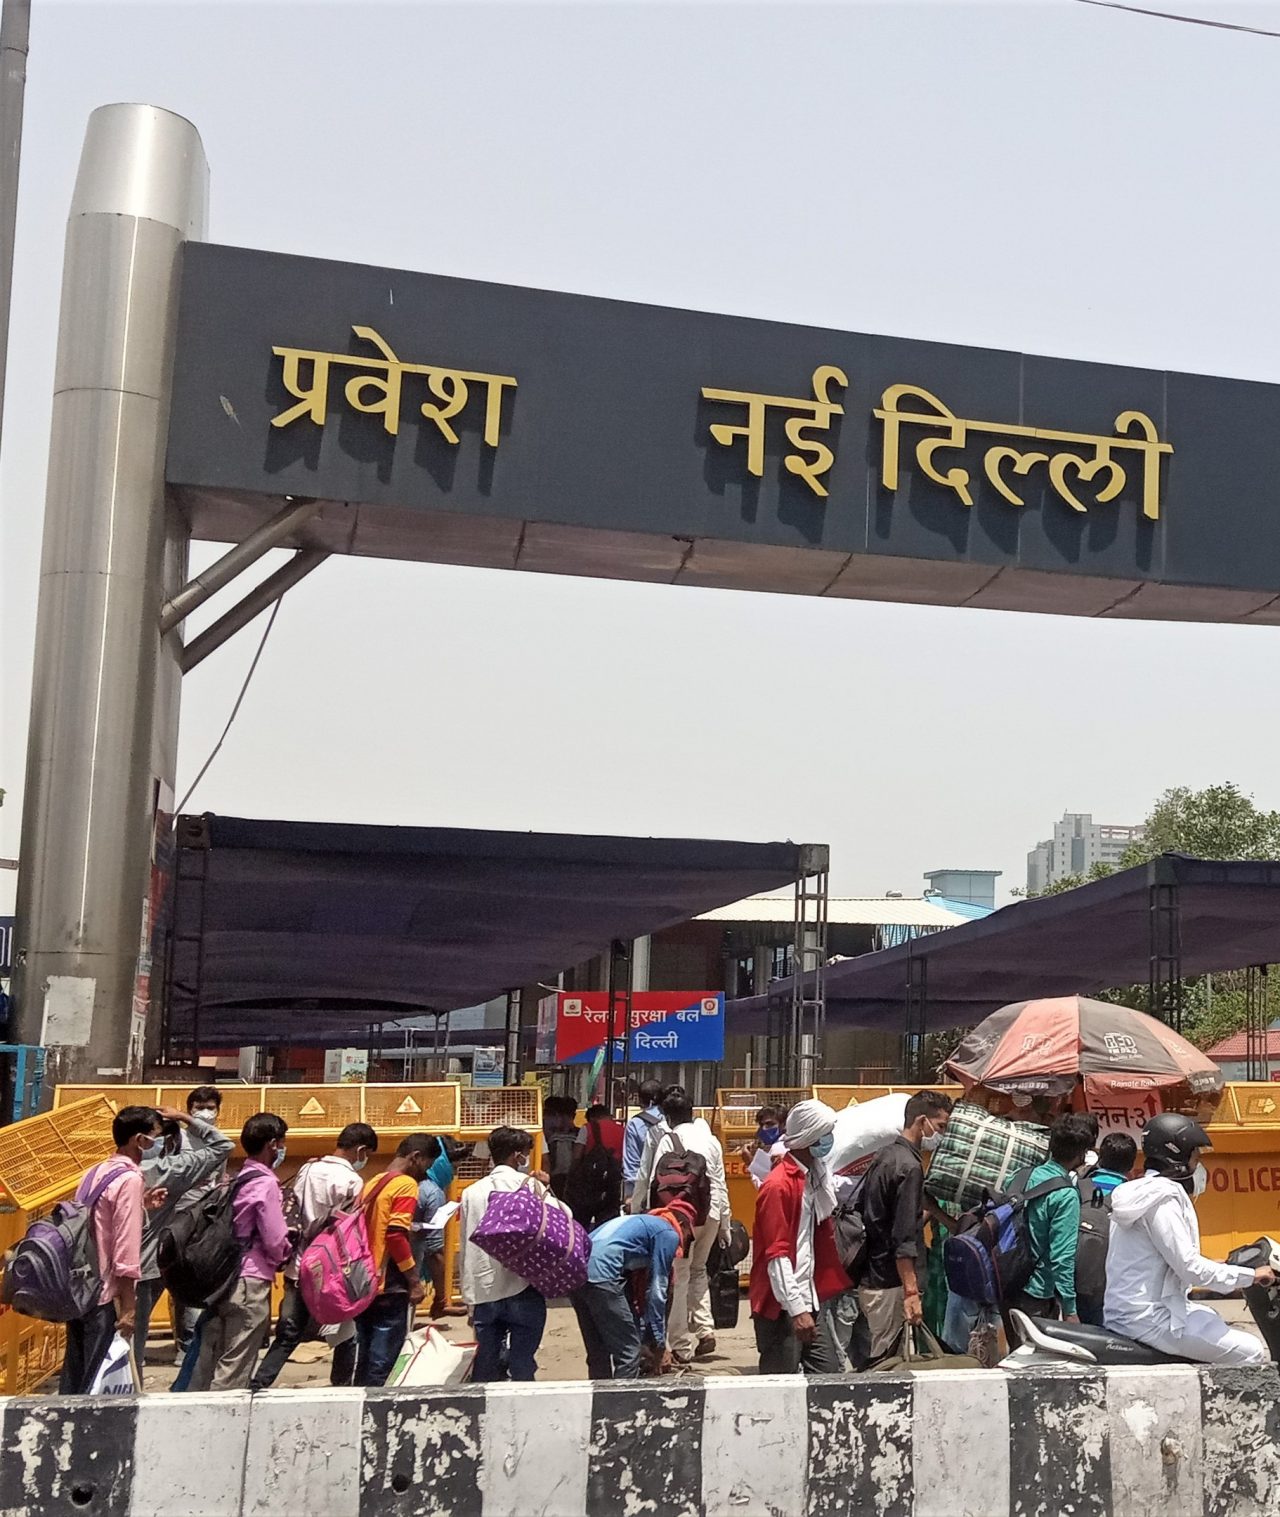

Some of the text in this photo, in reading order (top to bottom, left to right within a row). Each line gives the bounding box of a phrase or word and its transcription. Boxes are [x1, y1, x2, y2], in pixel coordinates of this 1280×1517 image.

[271, 325, 518, 447] प्रवेश
[701, 365, 1175, 520] नई दिल्ली
[676, 1009, 699, 1023] बल
[635, 1031, 678, 1049] दिल्ली
[1103, 1034, 1136, 1049] RED
